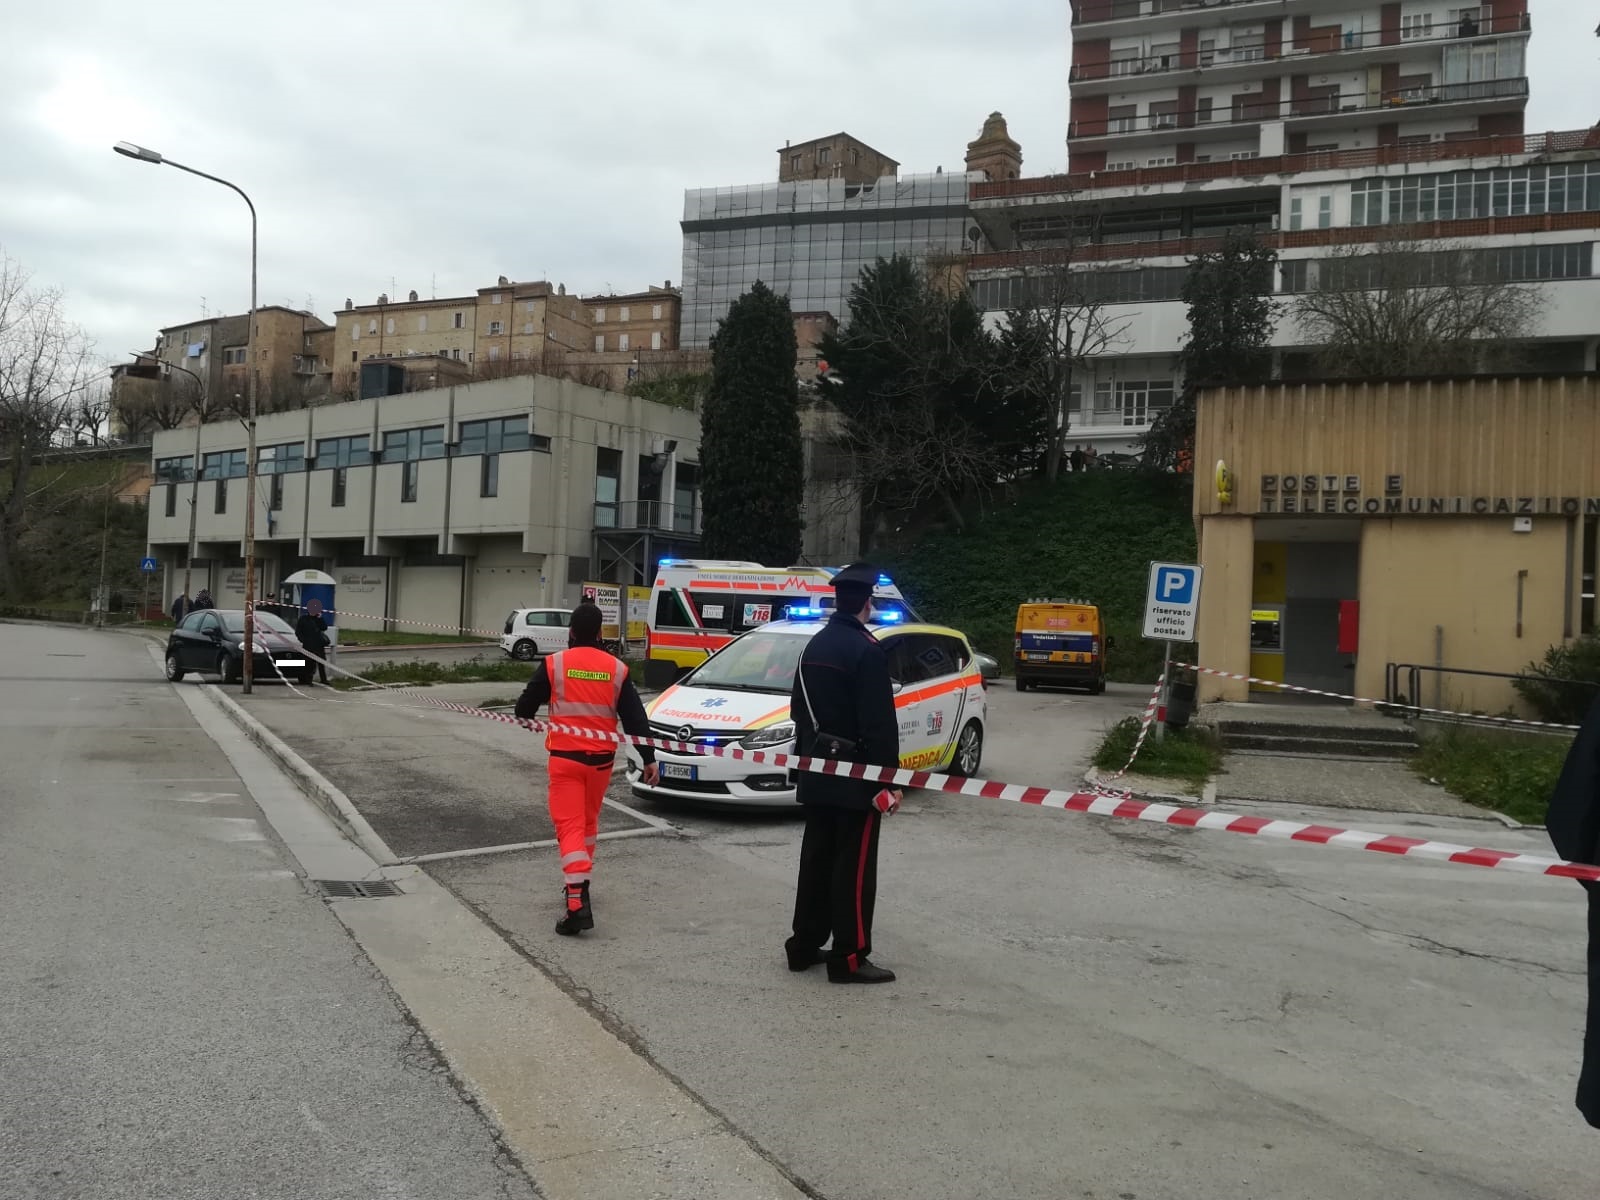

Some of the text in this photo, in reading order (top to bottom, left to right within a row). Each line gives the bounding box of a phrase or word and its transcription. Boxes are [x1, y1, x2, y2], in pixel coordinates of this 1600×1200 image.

[1263, 475, 1402, 490] POSTE E
[1163, 572, 1186, 598] P
[752, 610, 769, 621] 118
[1152, 607, 1191, 616] riservato
[1157, 617, 1185, 626] ufficio
[1153, 627, 1186, 636] postale
[569, 670, 609, 679] SOCCORRITORE
[932, 716, 943, 730] 118
